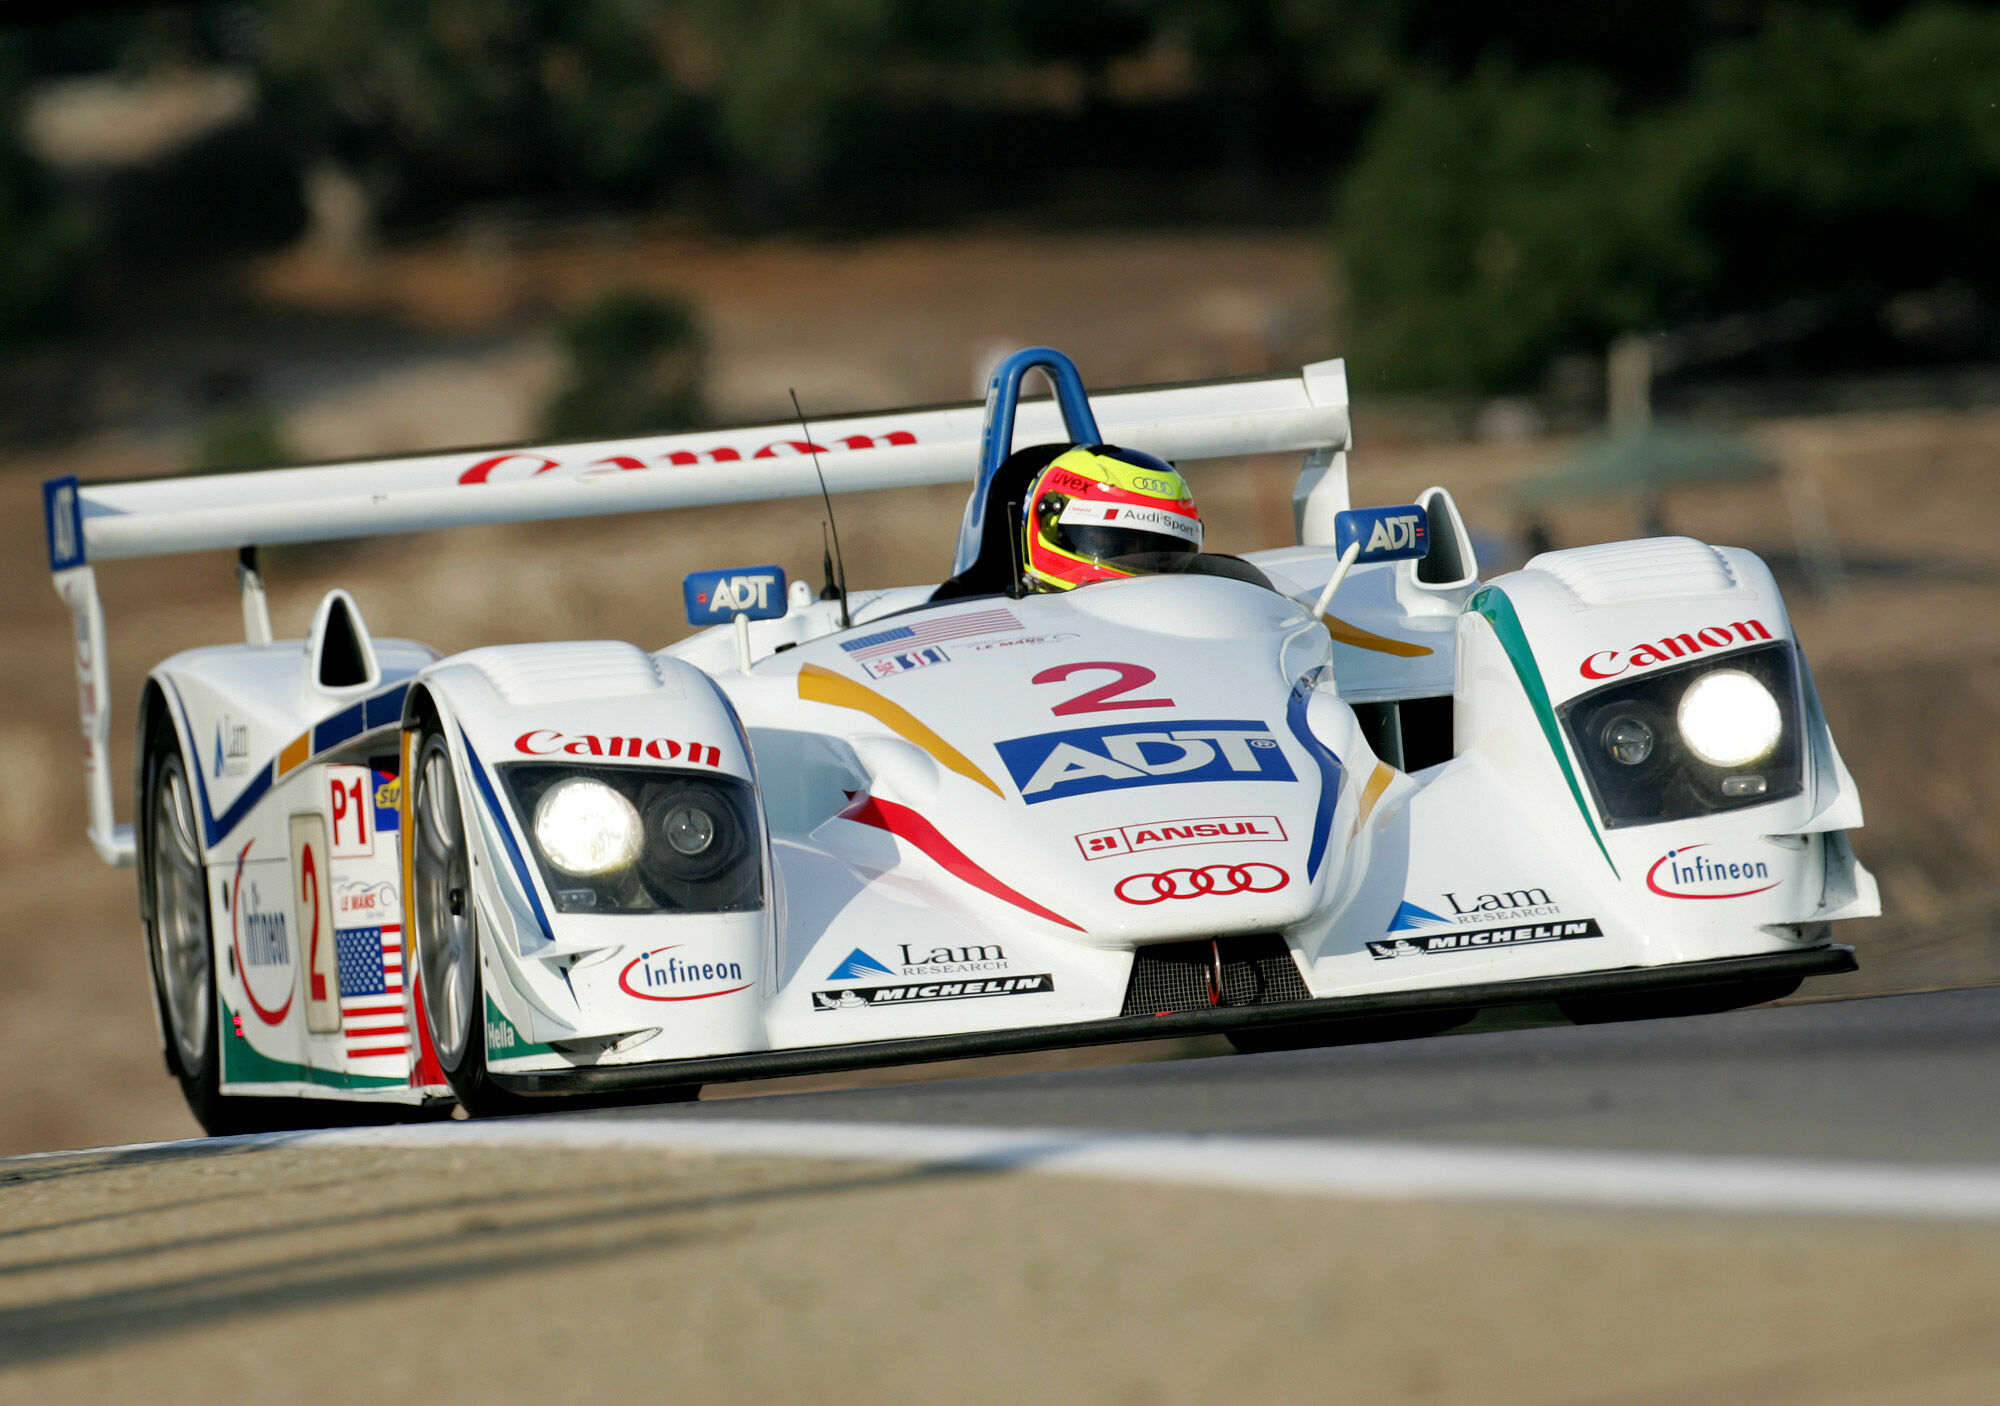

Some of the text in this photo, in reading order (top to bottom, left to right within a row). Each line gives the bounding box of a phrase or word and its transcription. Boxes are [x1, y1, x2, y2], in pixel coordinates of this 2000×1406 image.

[1052, 471, 1095, 495] uvex
[1124, 509, 1194, 537] Audi Sport
[1365, 515, 1419, 553] ADT
[709, 575, 775, 613] ADT
[1580, 619, 1772, 679] Canon
[1032, 661, 1176, 716] 2
[514, 729, 721, 767] Canon
[331, 776, 366, 846] P1
[1135, 822, 1269, 844] ANSUL
[1442, 887, 1555, 915] Lam
[1457, 905, 1561, 924] RESEARCH
[302, 842, 327, 1001] 2
[1427, 922, 1588, 949] MICHELIN
[897, 943, 1008, 966] Lam
[903, 961, 1008, 976] RESEARCH
[873, 977, 1042, 1001] MICHELIN
[487, 1020, 515, 1049] Hella
